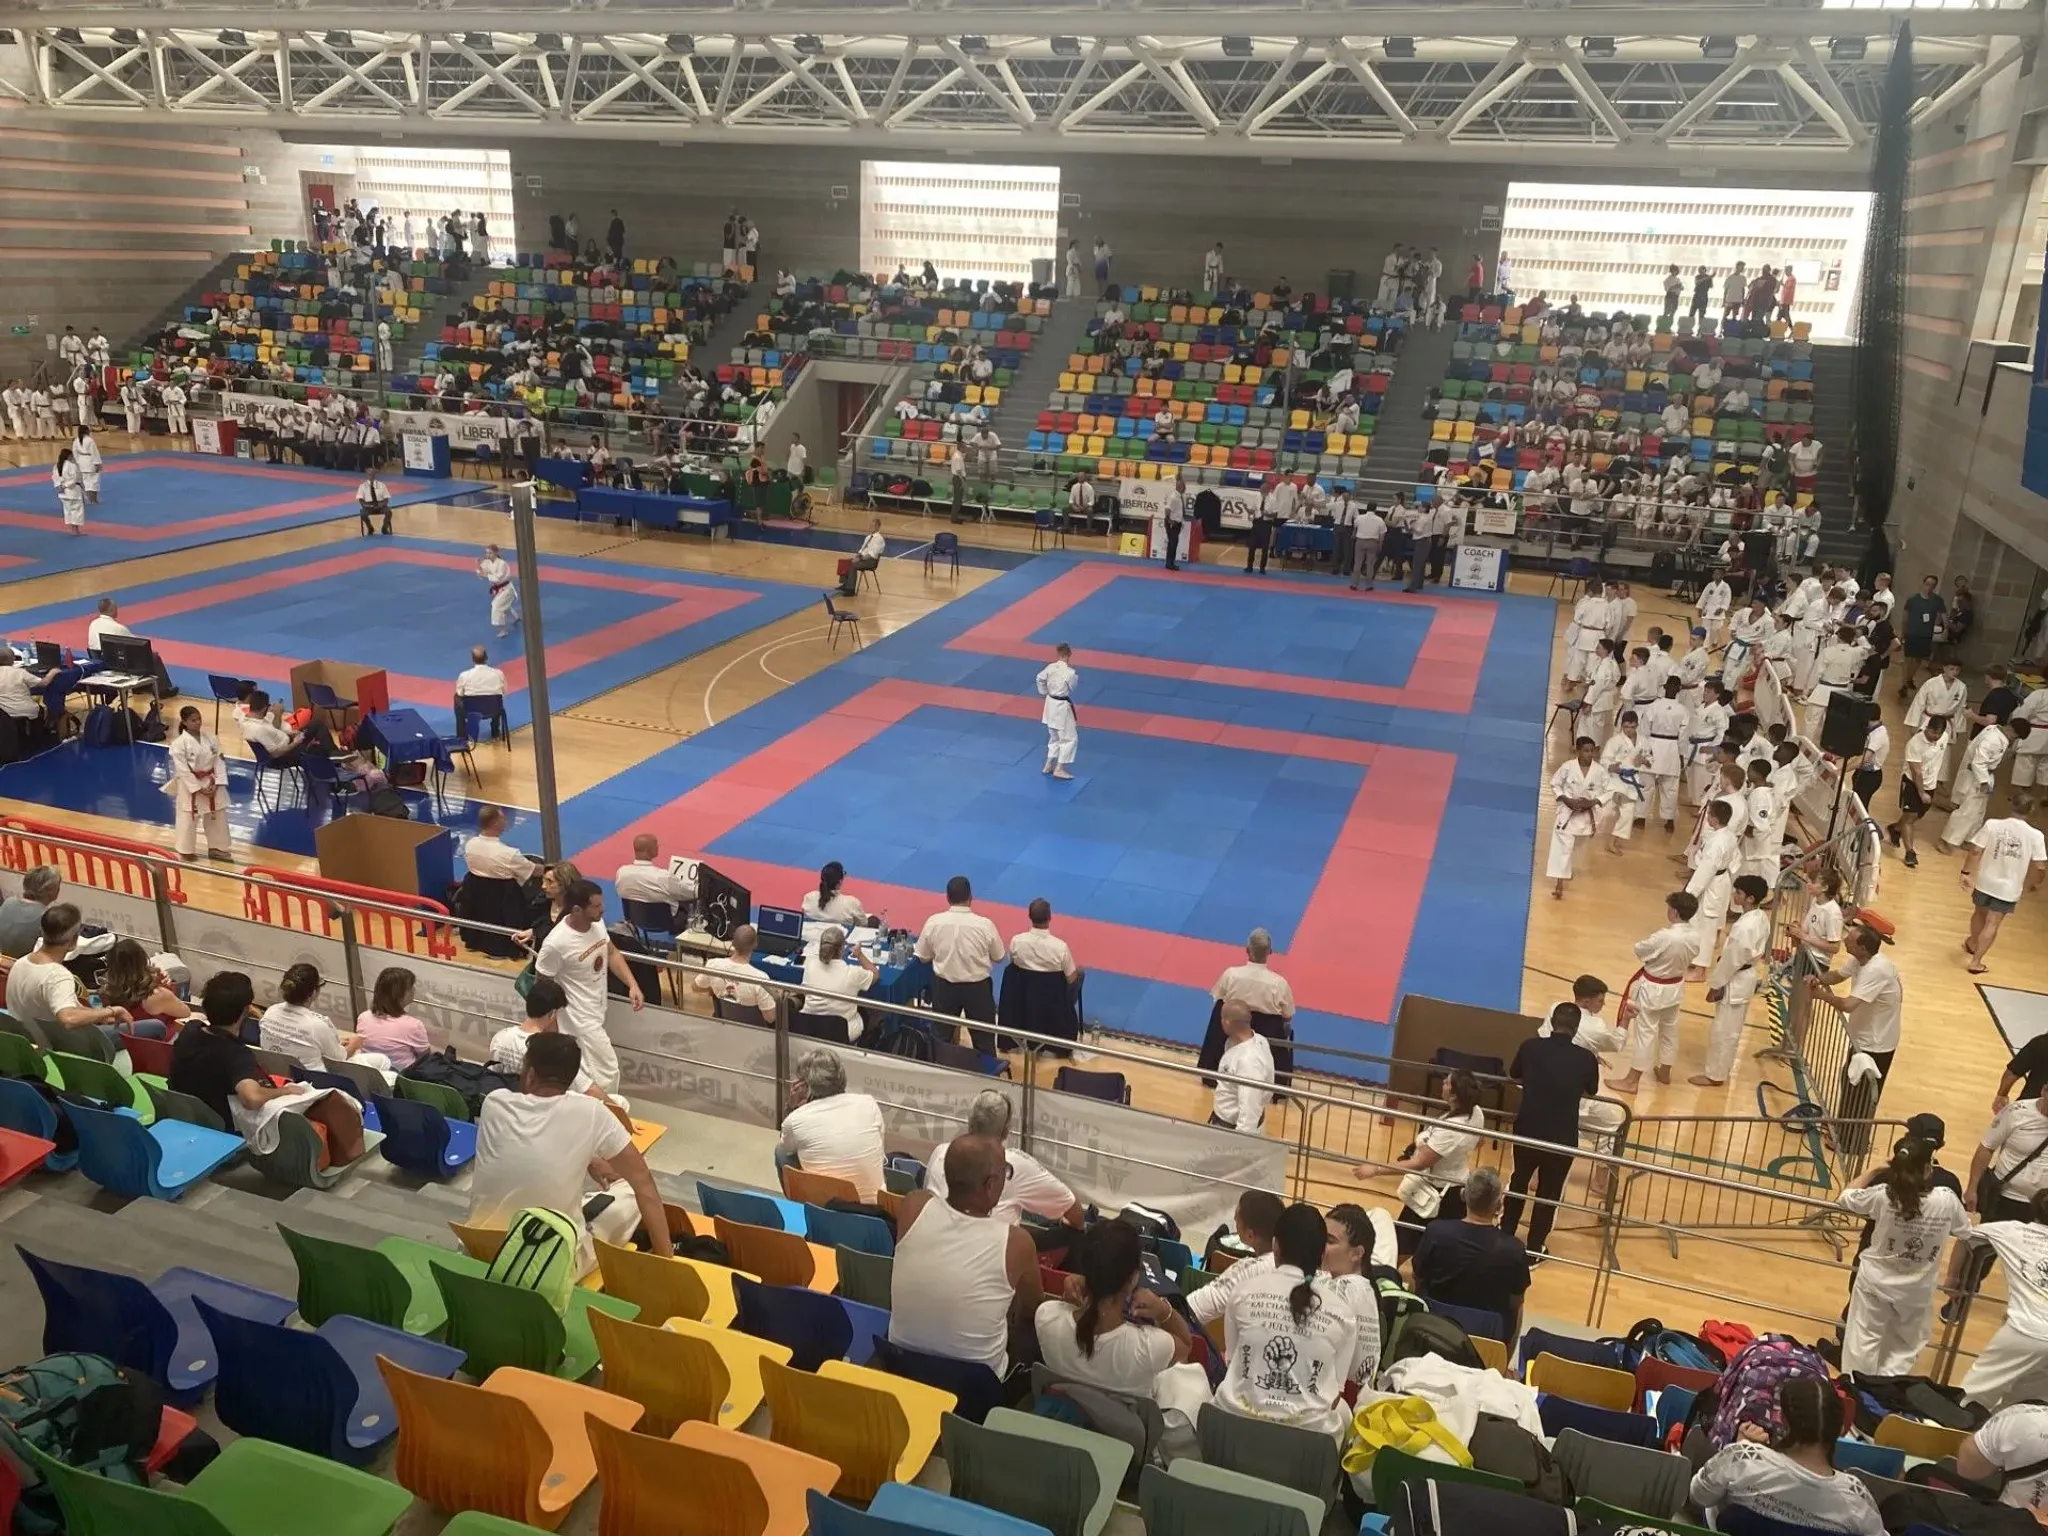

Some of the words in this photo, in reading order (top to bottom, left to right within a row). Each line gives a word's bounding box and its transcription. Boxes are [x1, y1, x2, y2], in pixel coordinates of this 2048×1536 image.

[462, 425, 495, 439] LIBER
[1130, 538, 1138, 547] C
[1464, 548, 1495, 558] COACH
[673, 860, 698, 880] 7,0
[1251, 1293, 1289, 1302] EUROPEA
